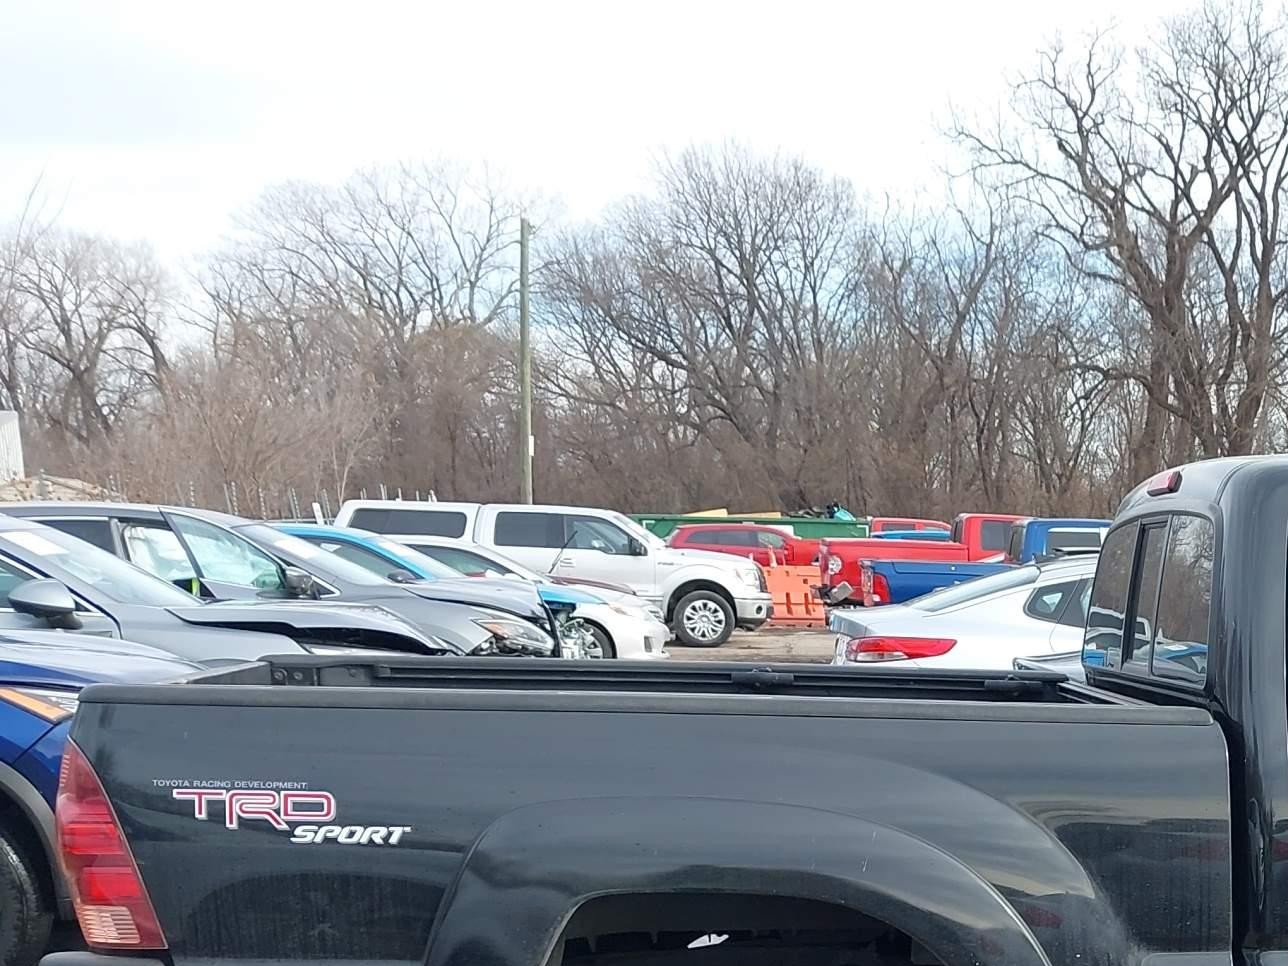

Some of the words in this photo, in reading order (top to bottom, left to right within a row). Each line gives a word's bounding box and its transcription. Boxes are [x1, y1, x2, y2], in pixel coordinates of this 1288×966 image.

[152, 779, 190, 788] TOYOTA
[193, 780, 231, 789] RACING
[234, 780, 307, 790] DEVELOPMENT
[172, 788, 336, 831] TRD
[290, 825, 412, 845] SPORT
